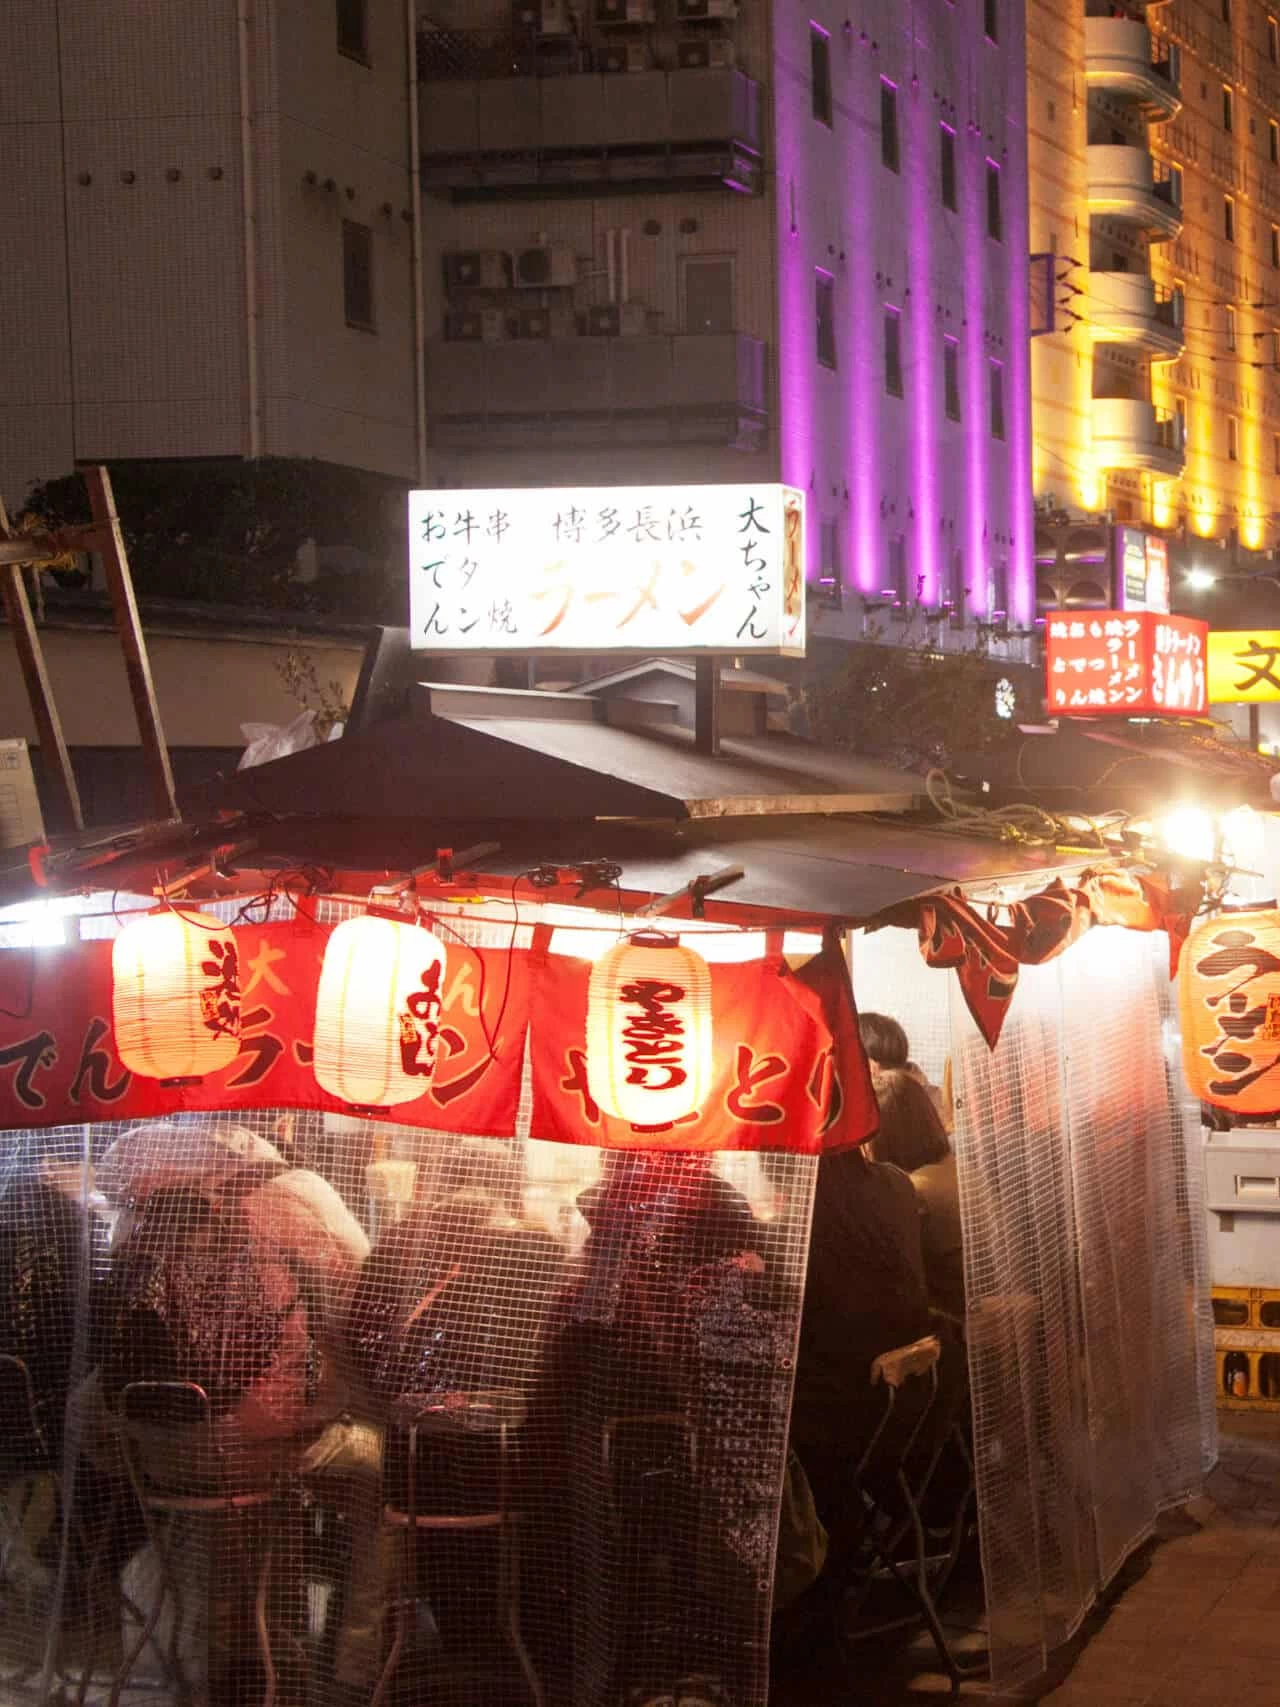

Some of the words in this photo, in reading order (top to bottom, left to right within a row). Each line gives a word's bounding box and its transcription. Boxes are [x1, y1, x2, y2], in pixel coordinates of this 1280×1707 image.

[421, 510, 448, 636] おでん
[453, 510, 480, 634] 牛タン
[485, 510, 518, 635] 串焼
[552, 505, 704, 545] 博多長浜
[735, 496, 772, 640] 大ちゃん
[531, 559, 726, 637] ラーメン
[1124, 618, 1143, 704] ラーメン
[618, 979, 688, 1091] やきとり
